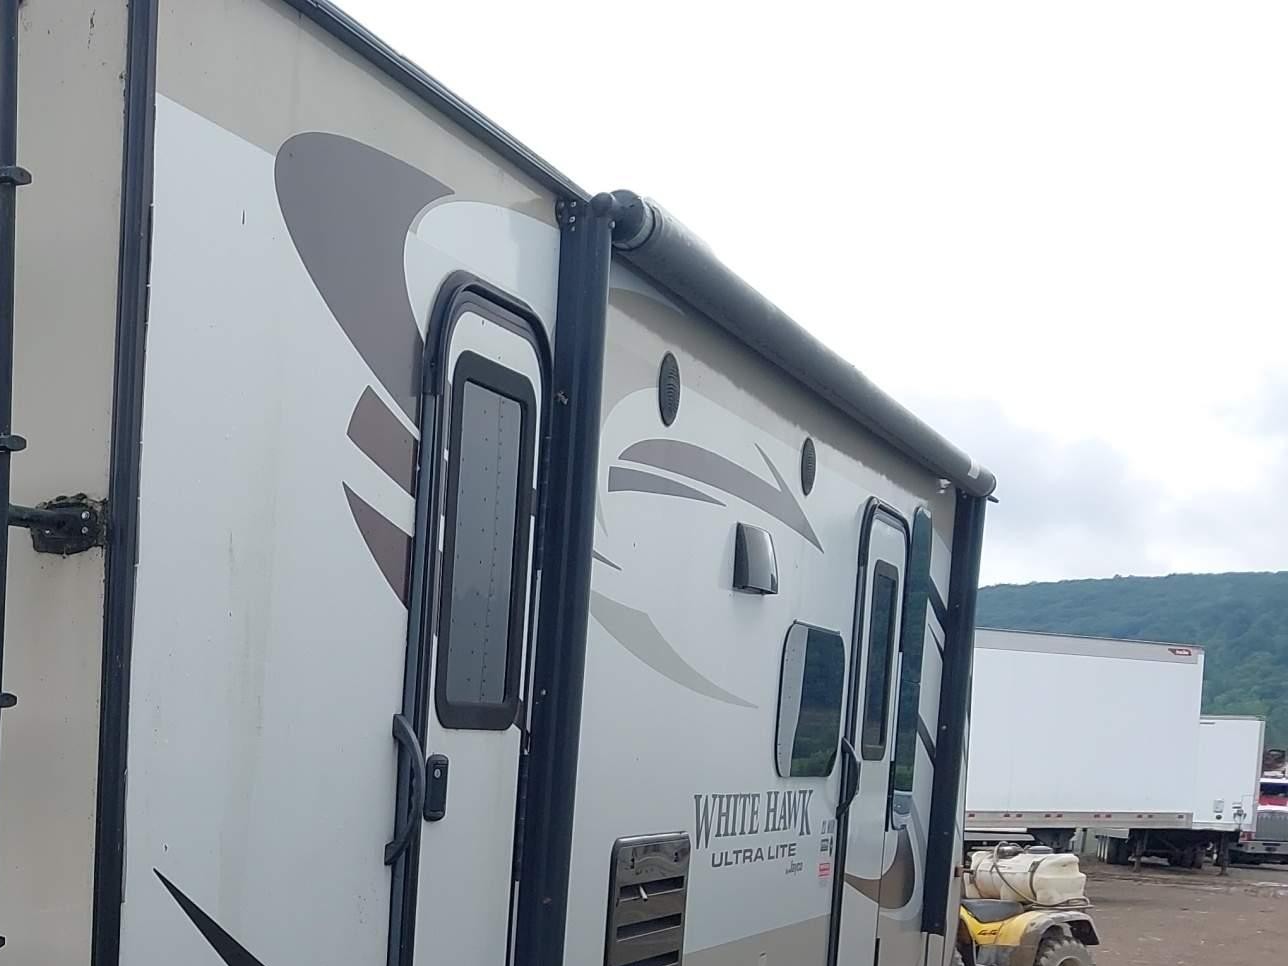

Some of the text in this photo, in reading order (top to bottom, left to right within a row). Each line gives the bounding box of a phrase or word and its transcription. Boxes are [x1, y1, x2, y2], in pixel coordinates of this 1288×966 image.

[693, 789, 814, 850] WHITE HAWK
[712, 848, 764, 868] ULTRA
[768, 843, 797, 860] LITE
